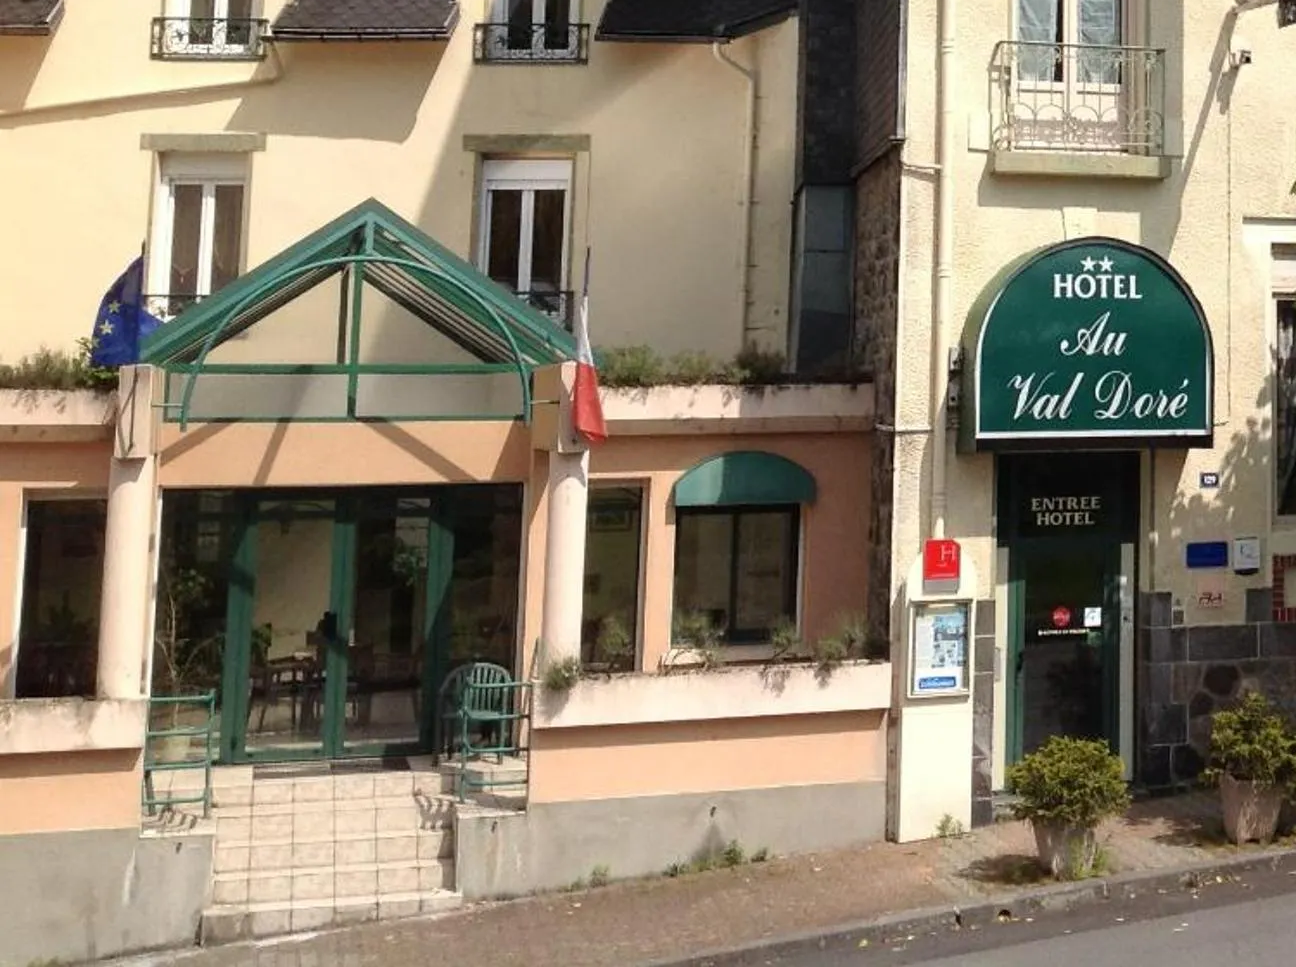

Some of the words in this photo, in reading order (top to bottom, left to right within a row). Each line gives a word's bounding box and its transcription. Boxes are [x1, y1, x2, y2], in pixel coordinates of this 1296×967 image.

[1053, 273, 1143, 299] HOTEL
[1060, 311, 1129, 357] Au
[1007, 372, 1085, 421] Val
[1094, 370, 1189, 420] Doré
[1031, 496, 1102, 511] ENTREE
[1036, 511, 1096, 527] HOTEL
